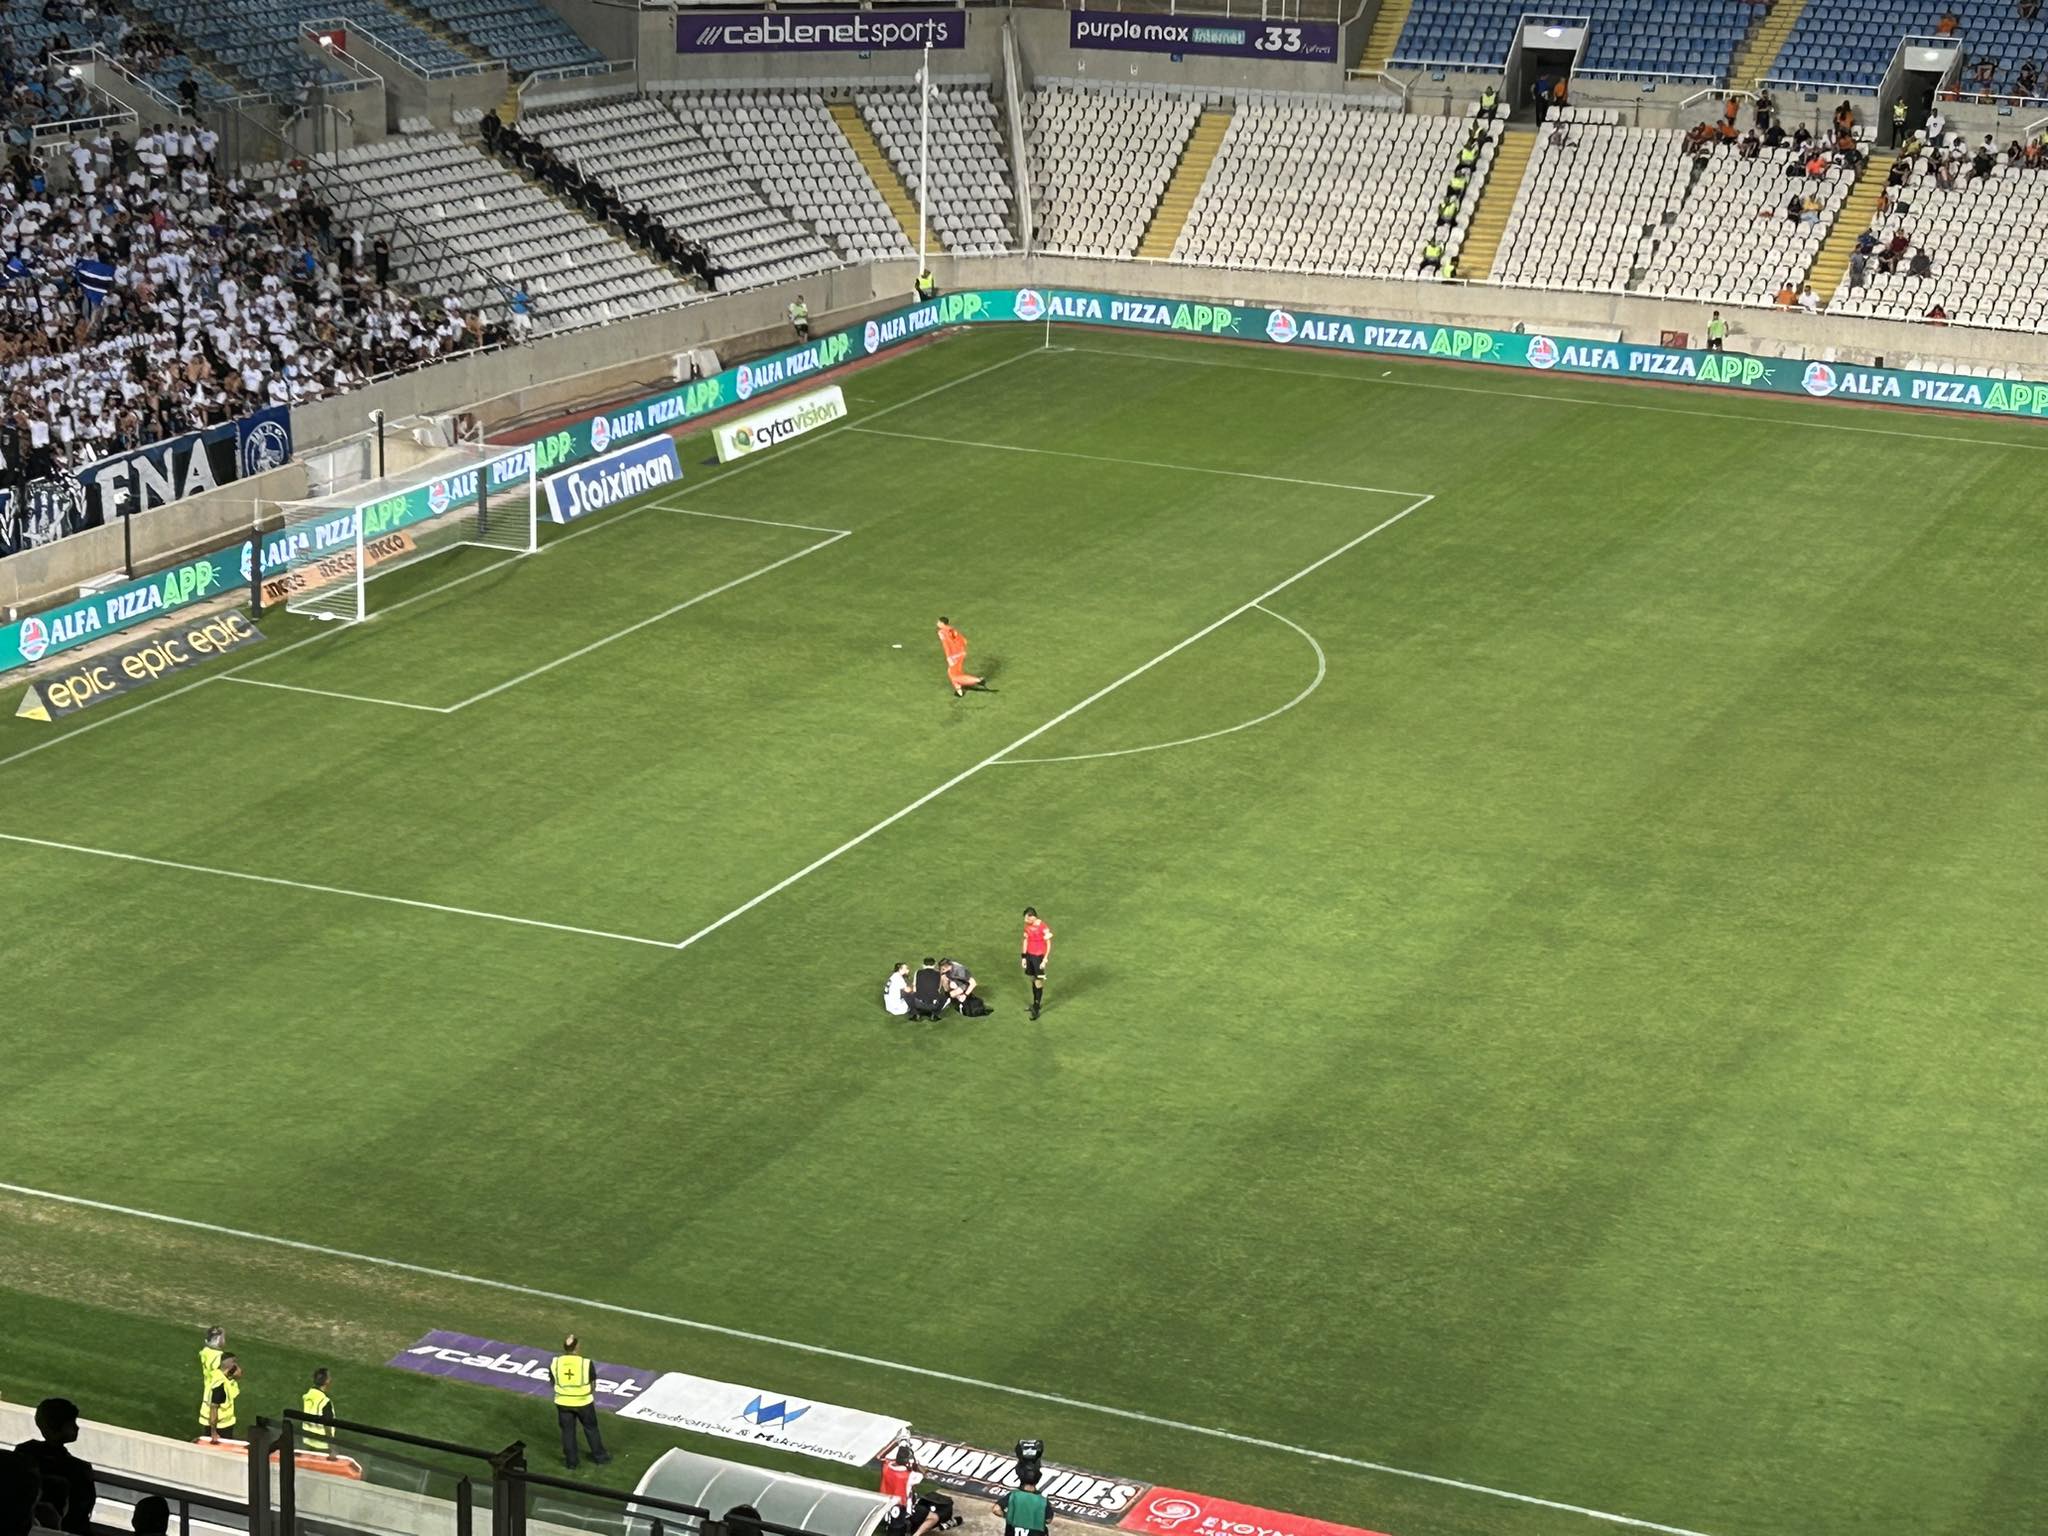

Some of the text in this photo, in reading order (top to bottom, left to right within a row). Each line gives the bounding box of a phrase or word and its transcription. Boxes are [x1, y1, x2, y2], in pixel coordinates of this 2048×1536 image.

[1077, 20, 1142, 42] purple
[1144, 25, 1189, 42] max
[880, 293, 982, 342] ALFA PIZZA APP
[1047, 296, 1232, 333] ALFA PIZZA APP
[1297, 319, 1493, 359] ALFA PIZZA APP
[753, 333, 849, 388] ALFA PIZZA APP
[1561, 345, 1763, 385] ALFA PIZZA APP
[611, 378, 720, 440] ALFA PIZZA APP
[1838, 371, 1901, 397] ALFA
[1911, 379, 1982, 405] PIZZA
[756, 401, 838, 445] cytavision
[451, 471, 479, 500] ALF
[536, 431, 571, 472] APP
[567, 453, 674, 518] Stoiximan
[364, 496, 407, 536] APP
[50, 560, 213, 645] ALFA PIZZA APP
[187, 615, 252, 654] epic
[121, 640, 189, 680] epic
[48, 666, 116, 708] epic
[432, 1347, 643, 1398] cableet
